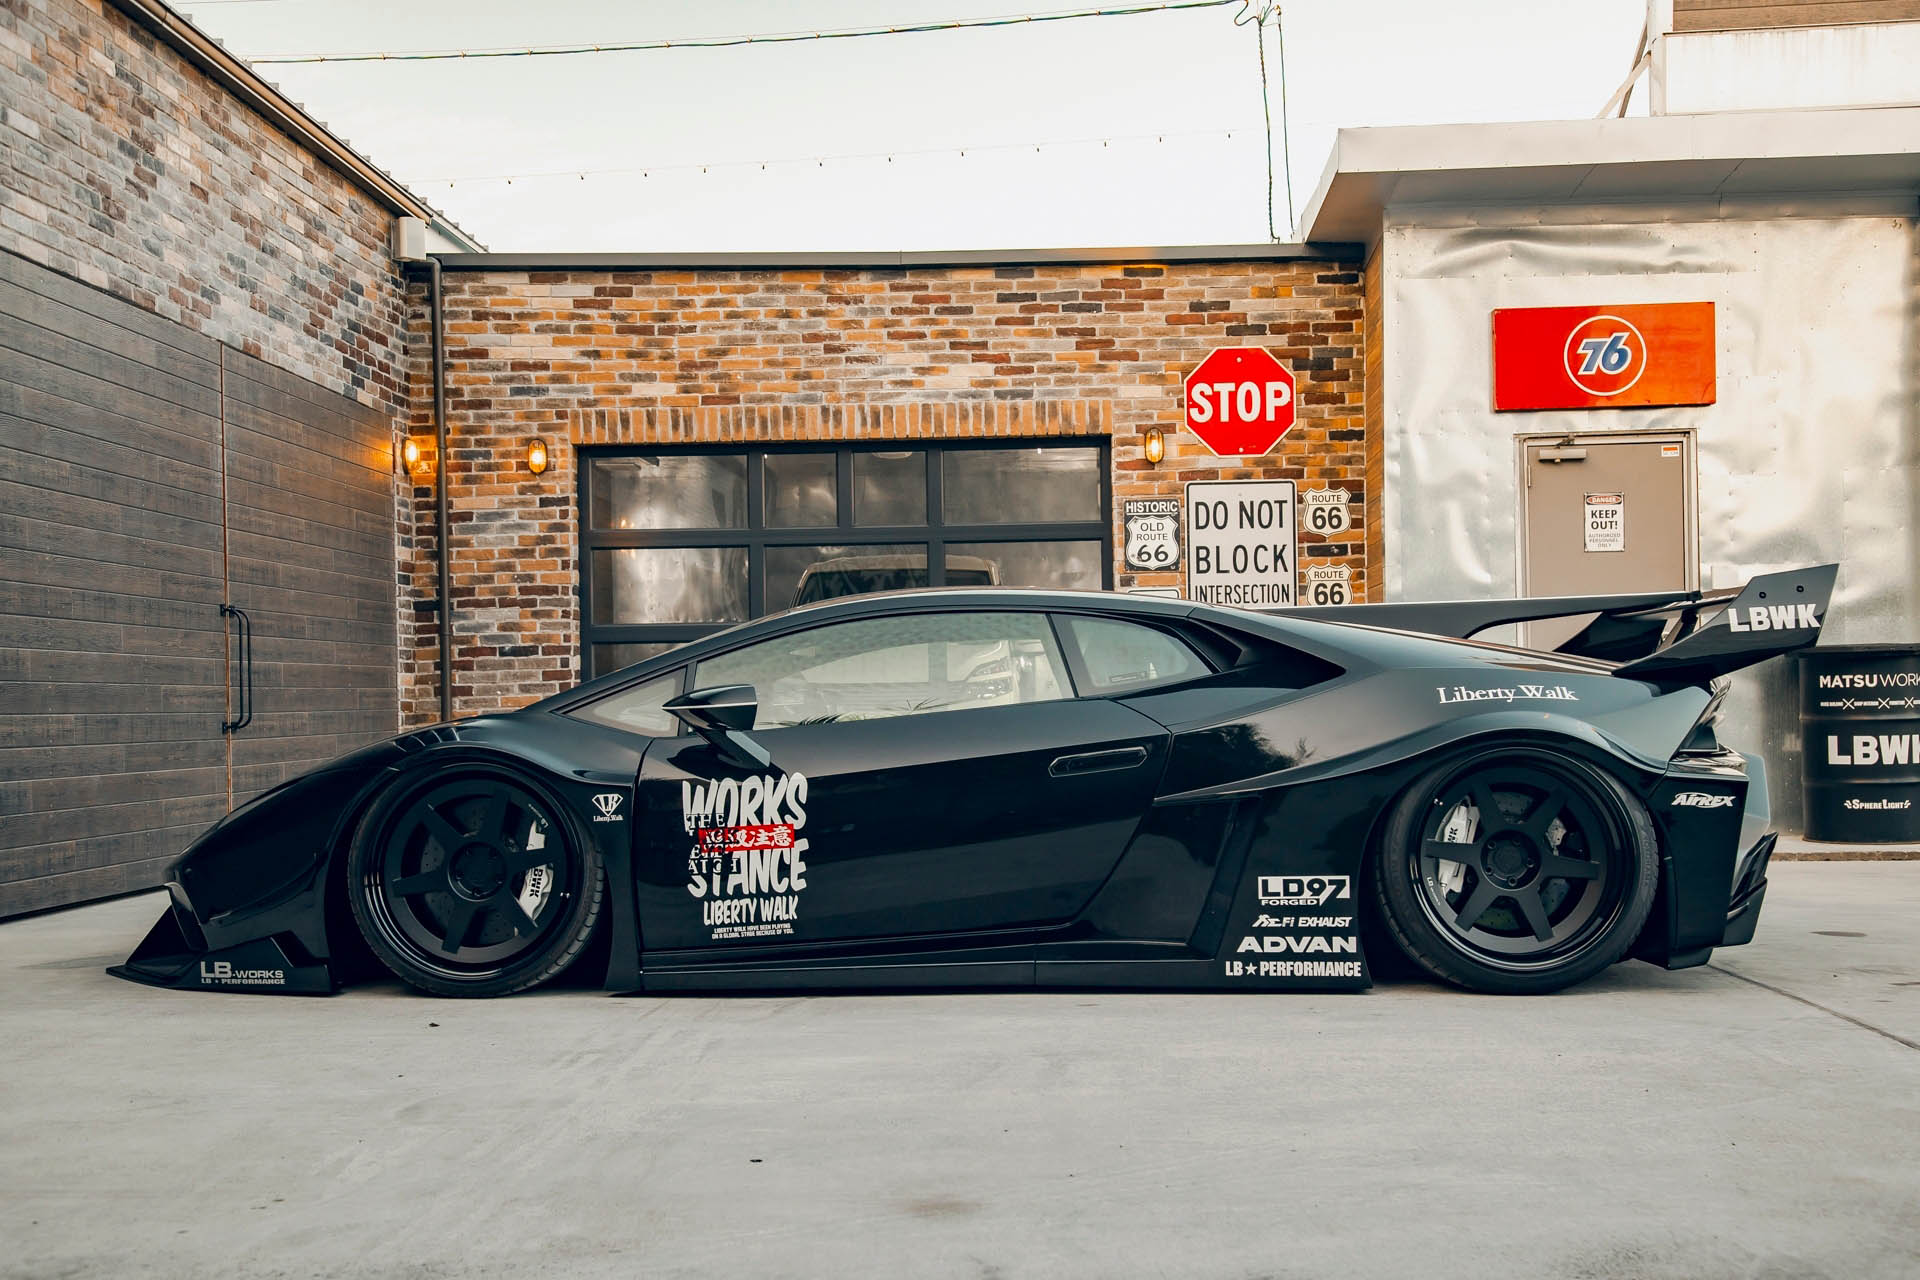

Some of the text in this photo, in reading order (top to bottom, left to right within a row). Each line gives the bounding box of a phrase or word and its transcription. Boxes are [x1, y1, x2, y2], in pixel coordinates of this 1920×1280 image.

[1576, 332, 1632, 376] 76
[1189, 381, 1292, 423] STOP
[1126, 501, 1178, 513] HISTORIC
[1312, 494, 1342, 503] ROUTE
[1194, 500, 1288, 530] DO NOT
[1312, 506, 1342, 530] 66
[1591, 509, 1618, 519] KEEP
[1140, 522, 1165, 532] OLD
[1591, 520, 1618, 530] OUT!
[1136, 533, 1169, 541] ROUTE
[1137, 544, 1169, 563] 66
[1195, 543, 1289, 574] BLOCK
[1314, 570, 1344, 579] ROUTE
[1195, 583, 1290, 604] INTERSECTION
[1314, 583, 1345, 606] 66
[1728, 603, 1821, 633] LBWK
[1436, 684, 1580, 703] Liberty Walk
[682, 772, 808, 832] WORKS
[1261, 877, 1348, 898] LD97
[703, 895, 799, 926] LIBERTY WALK
[1298, 917, 1352, 928] EXHAUST
[1236, 936, 1357, 953] ADVAN
